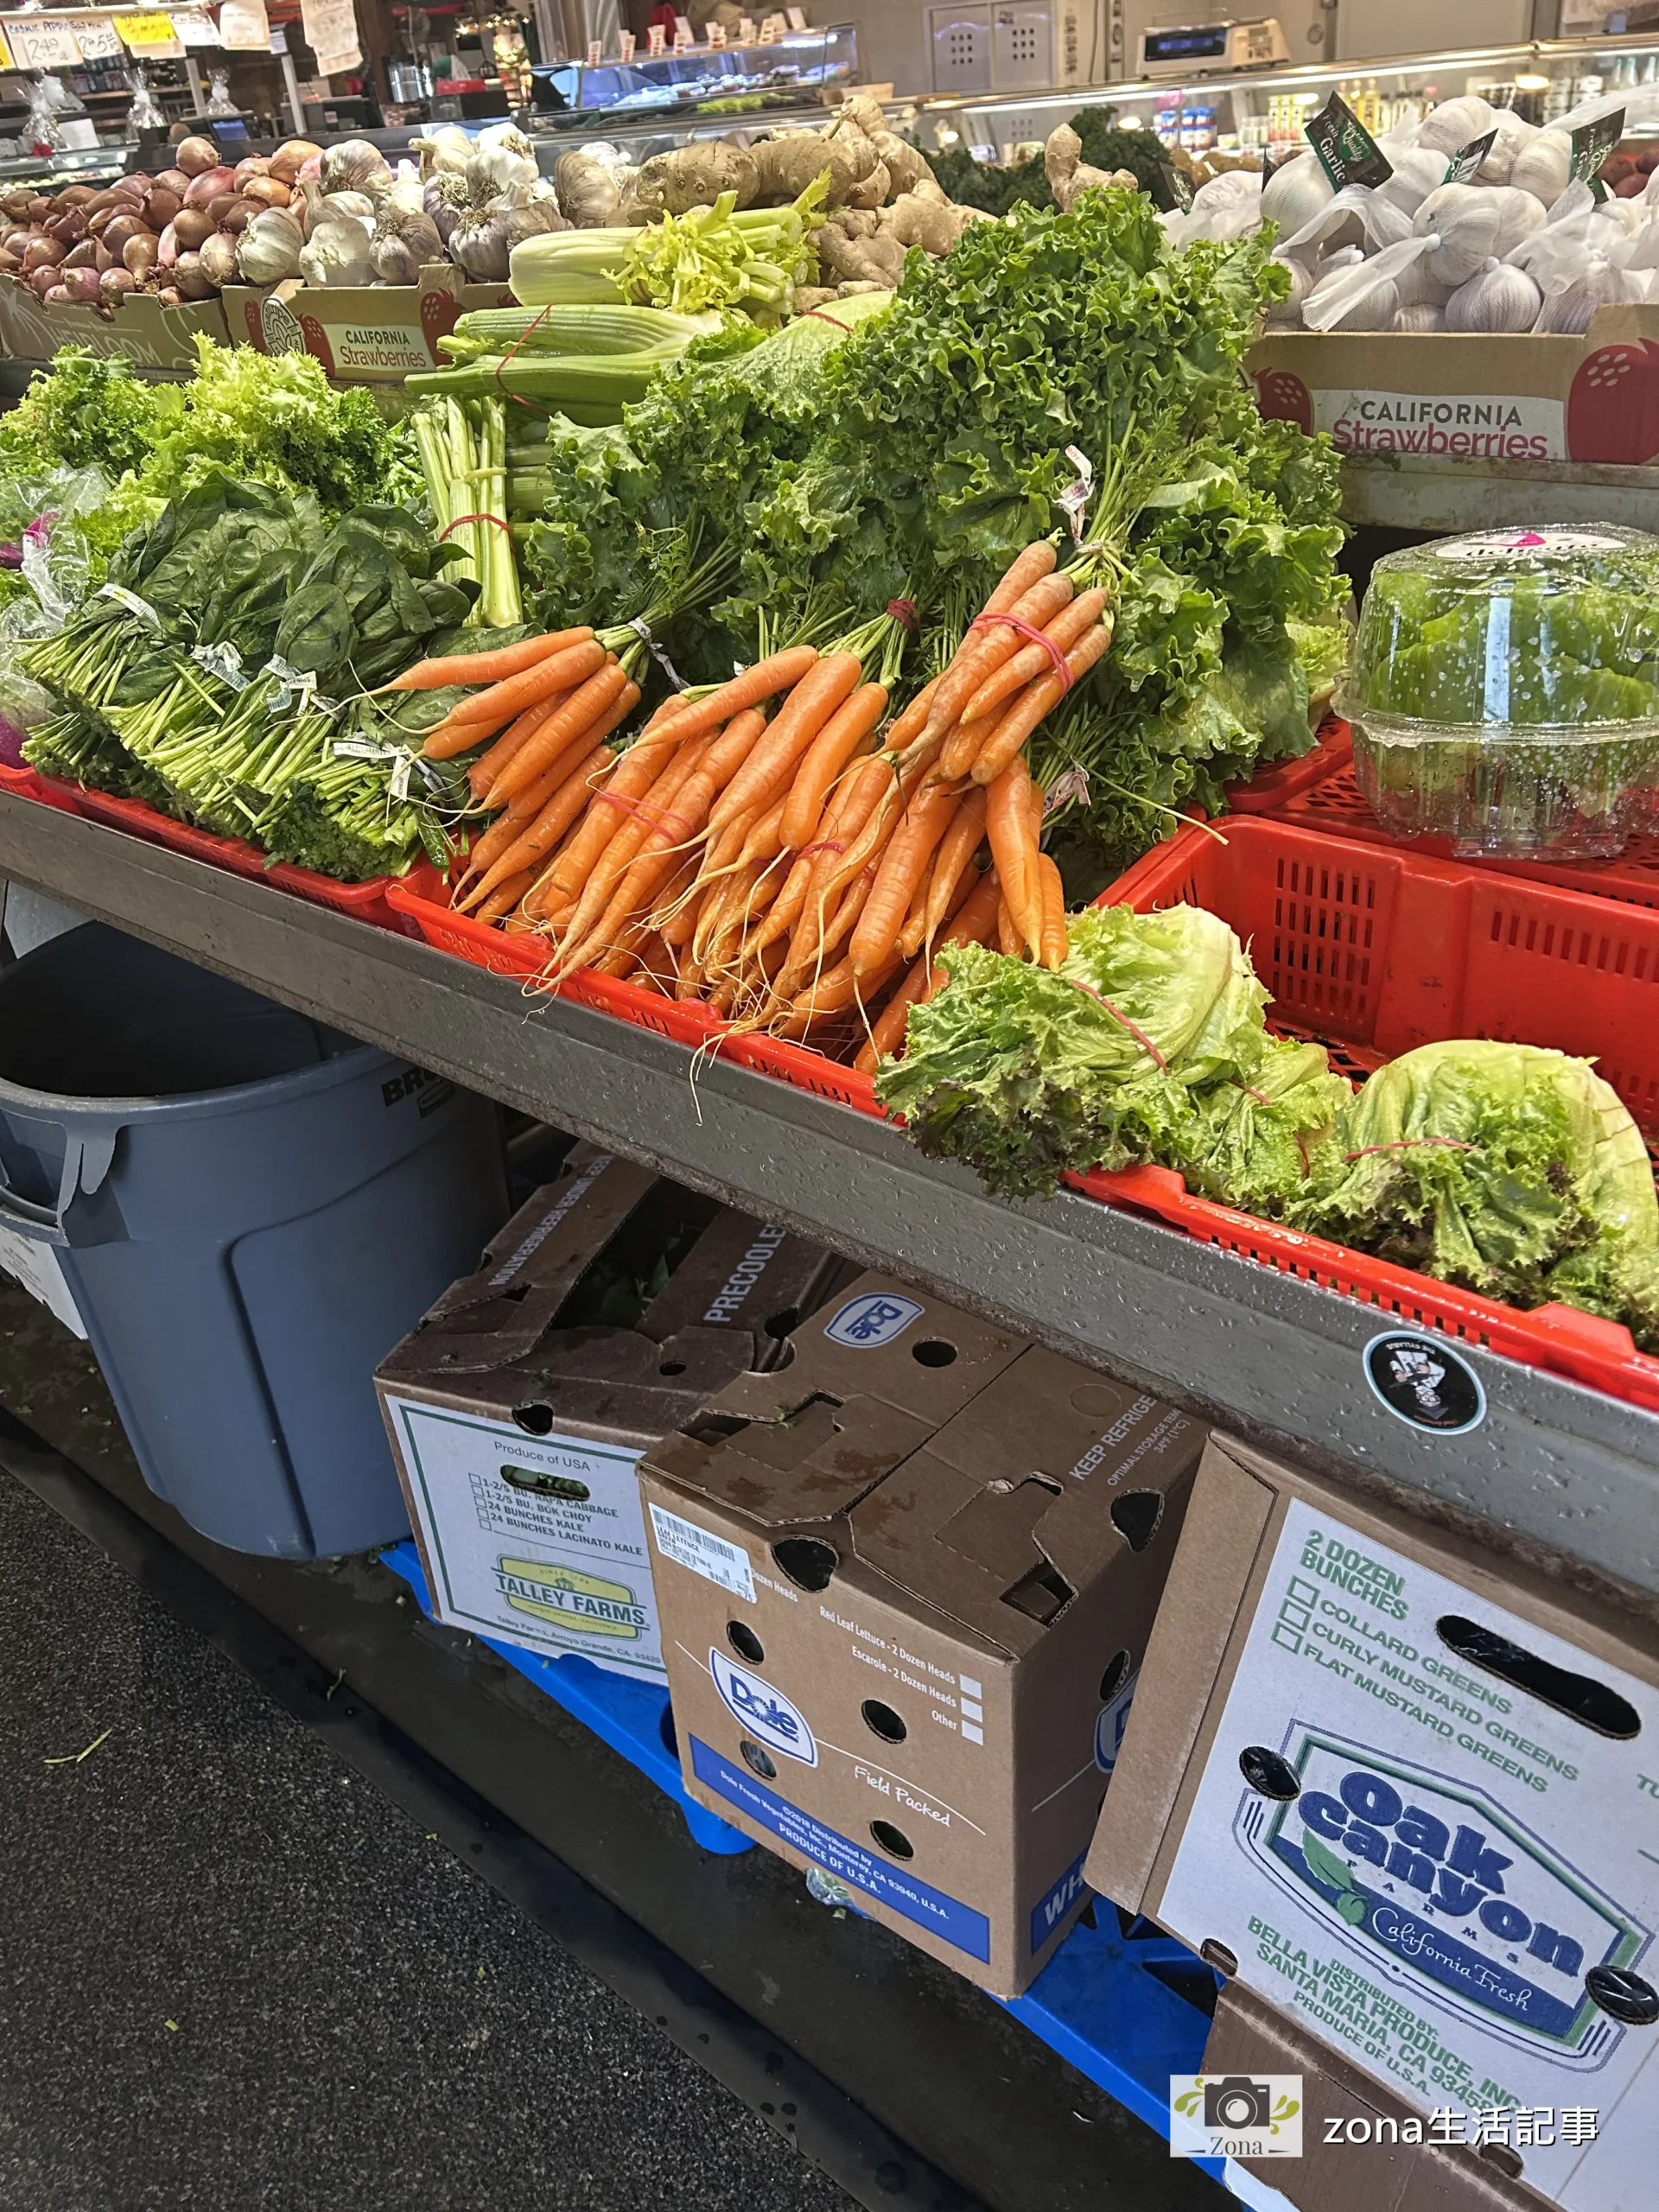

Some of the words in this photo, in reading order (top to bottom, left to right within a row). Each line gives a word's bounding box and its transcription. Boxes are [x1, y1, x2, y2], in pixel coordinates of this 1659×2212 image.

[1322, 115, 1339, 137] Fresh
[1319, 137, 1345, 182] Garlic
[340, 346, 426, 367] Strawberries
[346, 330, 410, 345] CALIFORNIA
[1361, 401, 1522, 426] CALIFORNIA
[1333, 420, 1548, 460] Strawberries
[556, 1176, 596, 1208] UNDER
[488, 1209, 569, 1286] REFRIGERATION
[851, 1302, 903, 1339] Dole
[1386, 1342, 1421, 1351] SYLLABUS
[494, 1441, 544, 1461] Produce
[548, 1455, 560, 1465] of
[563, 1457, 591, 1471] USA
[1069, 1444, 1107, 1481] KEEP
[1107, 1455, 1141, 1486] OPTIMAL
[1135, 1423, 1169, 1456] STORAGE
[483, 1478, 510, 1492] 1-2/5
[513, 1487, 531, 1498] BU.
[535, 1494, 563, 1506] NAPA
[566, 1500, 619, 1517] CABBAGE
[486, 1491, 512, 1504] 1-2/5
[516, 1498, 534, 1510] BU.
[537, 1504, 560, 1516] BOK
[563, 1511, 592, 1523] CHOY
[487, 1502, 501, 1511] 24
[504, 1506, 553, 1525] BUNCHES
[556, 1520, 584, 1533] KALE
[490, 1513, 504, 1522] 24
[506, 1517, 556, 1536] BUNCHES
[559, 1531, 612, 1548] LACINATO
[614, 1542, 644, 1556] KALE
[674, 1535, 699, 1552] LETTUCE
[750, 1567, 773, 1588] Dozen
[774, 1580, 798, 1603] Heads
[1300, 1548, 1409, 1621] BUNCHES
[1305, 1529, 1324, 1552] 2
[1325, 1539, 1406, 1597] DOZEN
[495, 1573, 565, 1607] TALLEY
[573, 1595, 645, 1625] FARMS
[498, 1616, 519, 1628] Talley
[551, 1632, 579, 1645] Arroyo
[617, 1648, 632, 1657] CA.
[820, 1605, 836, 1623] Red
[837, 1614, 854, 1631] Leaf
[855, 1624, 886, 1649] Lettuce
[892, 1645, 899, 1656] 2
[899, 1648, 926, 1670] Dozen
[928, 1661, 956, 1684] Heads
[1319, 1599, 1420, 1662] COLLARD
[1421, 1656, 1514, 1715] GREENS
[852, 1645, 887, 1673] Escarole
[893, 1669, 899, 1679] 2
[901, 1671, 927, 1694] Dozen
[929, 1685, 957, 1707] Heads
[729, 1673, 799, 1736] Dole
[931, 1710, 957, 1730] Other
[1304, 1643, 1355, 1678] FLAT
[1354, 1672, 1455, 1738] MUSTARD
[1457, 1732, 1549, 1793] GREENS
[1312, 1622, 1380, 1666] CURLY
[1379, 1659, 1484, 1726] MUSTARD
[1485, 1720, 1580, 1782] GREENS
[855, 1765, 891, 1796] Field
[895, 1787, 950, 1827] Packed
[720, 1770, 738, 1788] Dole
[739, 1783, 760, 1803] Fresh
[761, 1799, 807, 1836] Vegetables,
[829, 1844, 872, 1875] Monterey,
[873, 1870, 887, 1884] CA
[887, 1878, 919, 1903] 93940,
[921, 1898, 950, 1920] U.S.A.
[812, 1823, 859, 1859] Distributed
[861, 1853, 872, 1866] by
[1340, 1771, 1514, 1895] Oak
[779, 1822, 827, 1862] PRODUCE
[830, 1859, 844, 1870] OF
[847, 1866, 881, 1894] U.S.A.
[1372, 1907, 1472, 1978] California
[1474, 1964, 1533, 2012] Fresh
[1248, 1915, 1308, 1969] BELLA
[1313, 1958, 1368, 2011] VISTA
[1370, 2000, 1474, 2088] PRODUCE,
[1256, 1942, 1319, 1998] SANTA
[1321, 1989, 1391, 2051] MARIA,
[1398, 2044, 1427, 2073] CA
[1329, 1958, 1416, 2023] DISTRIBUTED
[1416, 2018, 1440, 2040] BY:
[1294, 1990, 1364, 2046] PRODUCE
[1364, 2041, 1387, 2060] OF
[1386, 2056, 1431, 2096] U.S.A.
